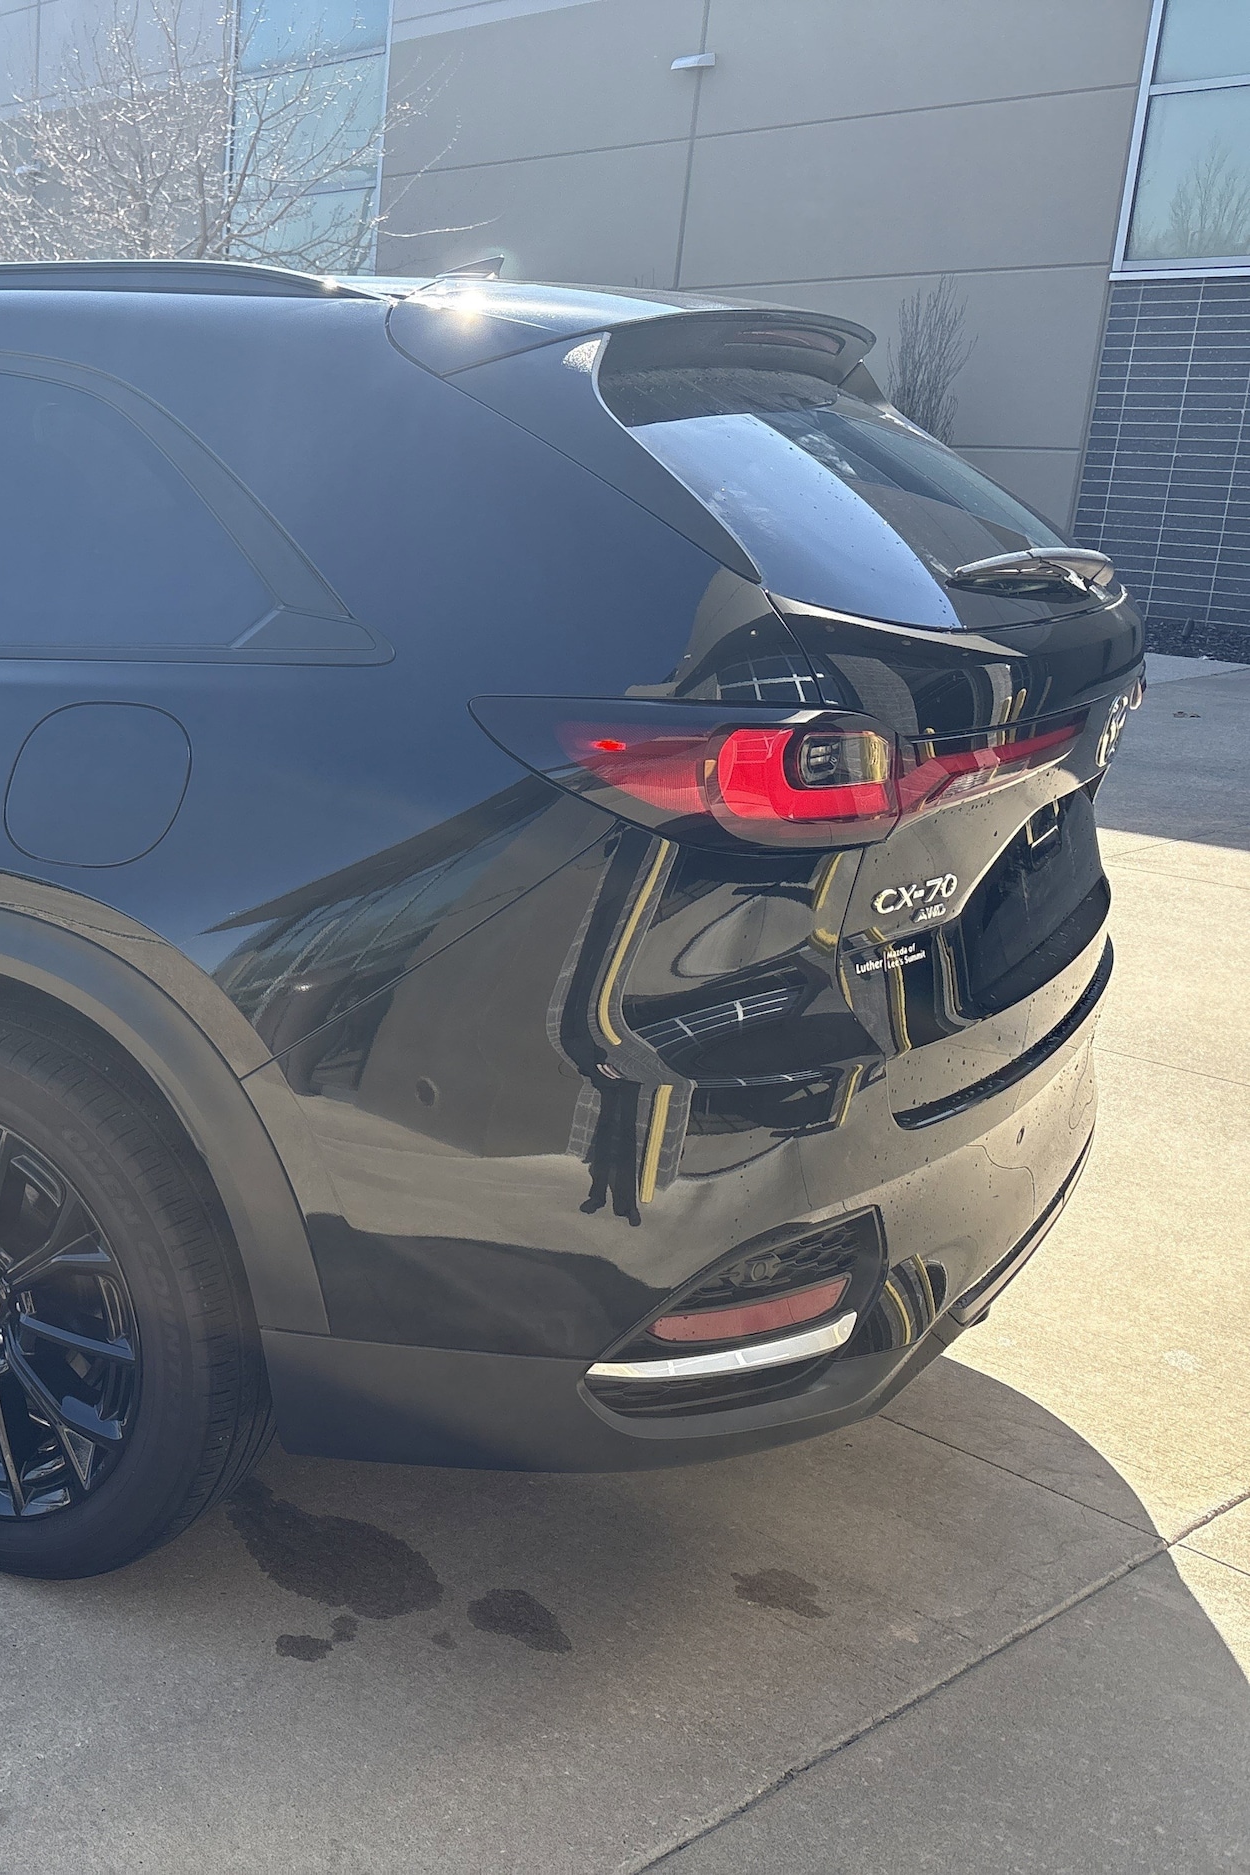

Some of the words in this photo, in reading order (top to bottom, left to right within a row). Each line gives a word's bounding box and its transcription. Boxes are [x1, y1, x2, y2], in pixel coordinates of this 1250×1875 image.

[872, 873, 958, 914] CX-70
[912, 903, 947, 923] AWD
[886, 946, 908, 960] Mazda
[908, 942, 916, 953] of
[887, 959, 904, 970] Lee's
[904, 949, 927, 965] Summit
[855, 959, 883, 975] Luther
[62, 1128, 142, 1225] OPEN
